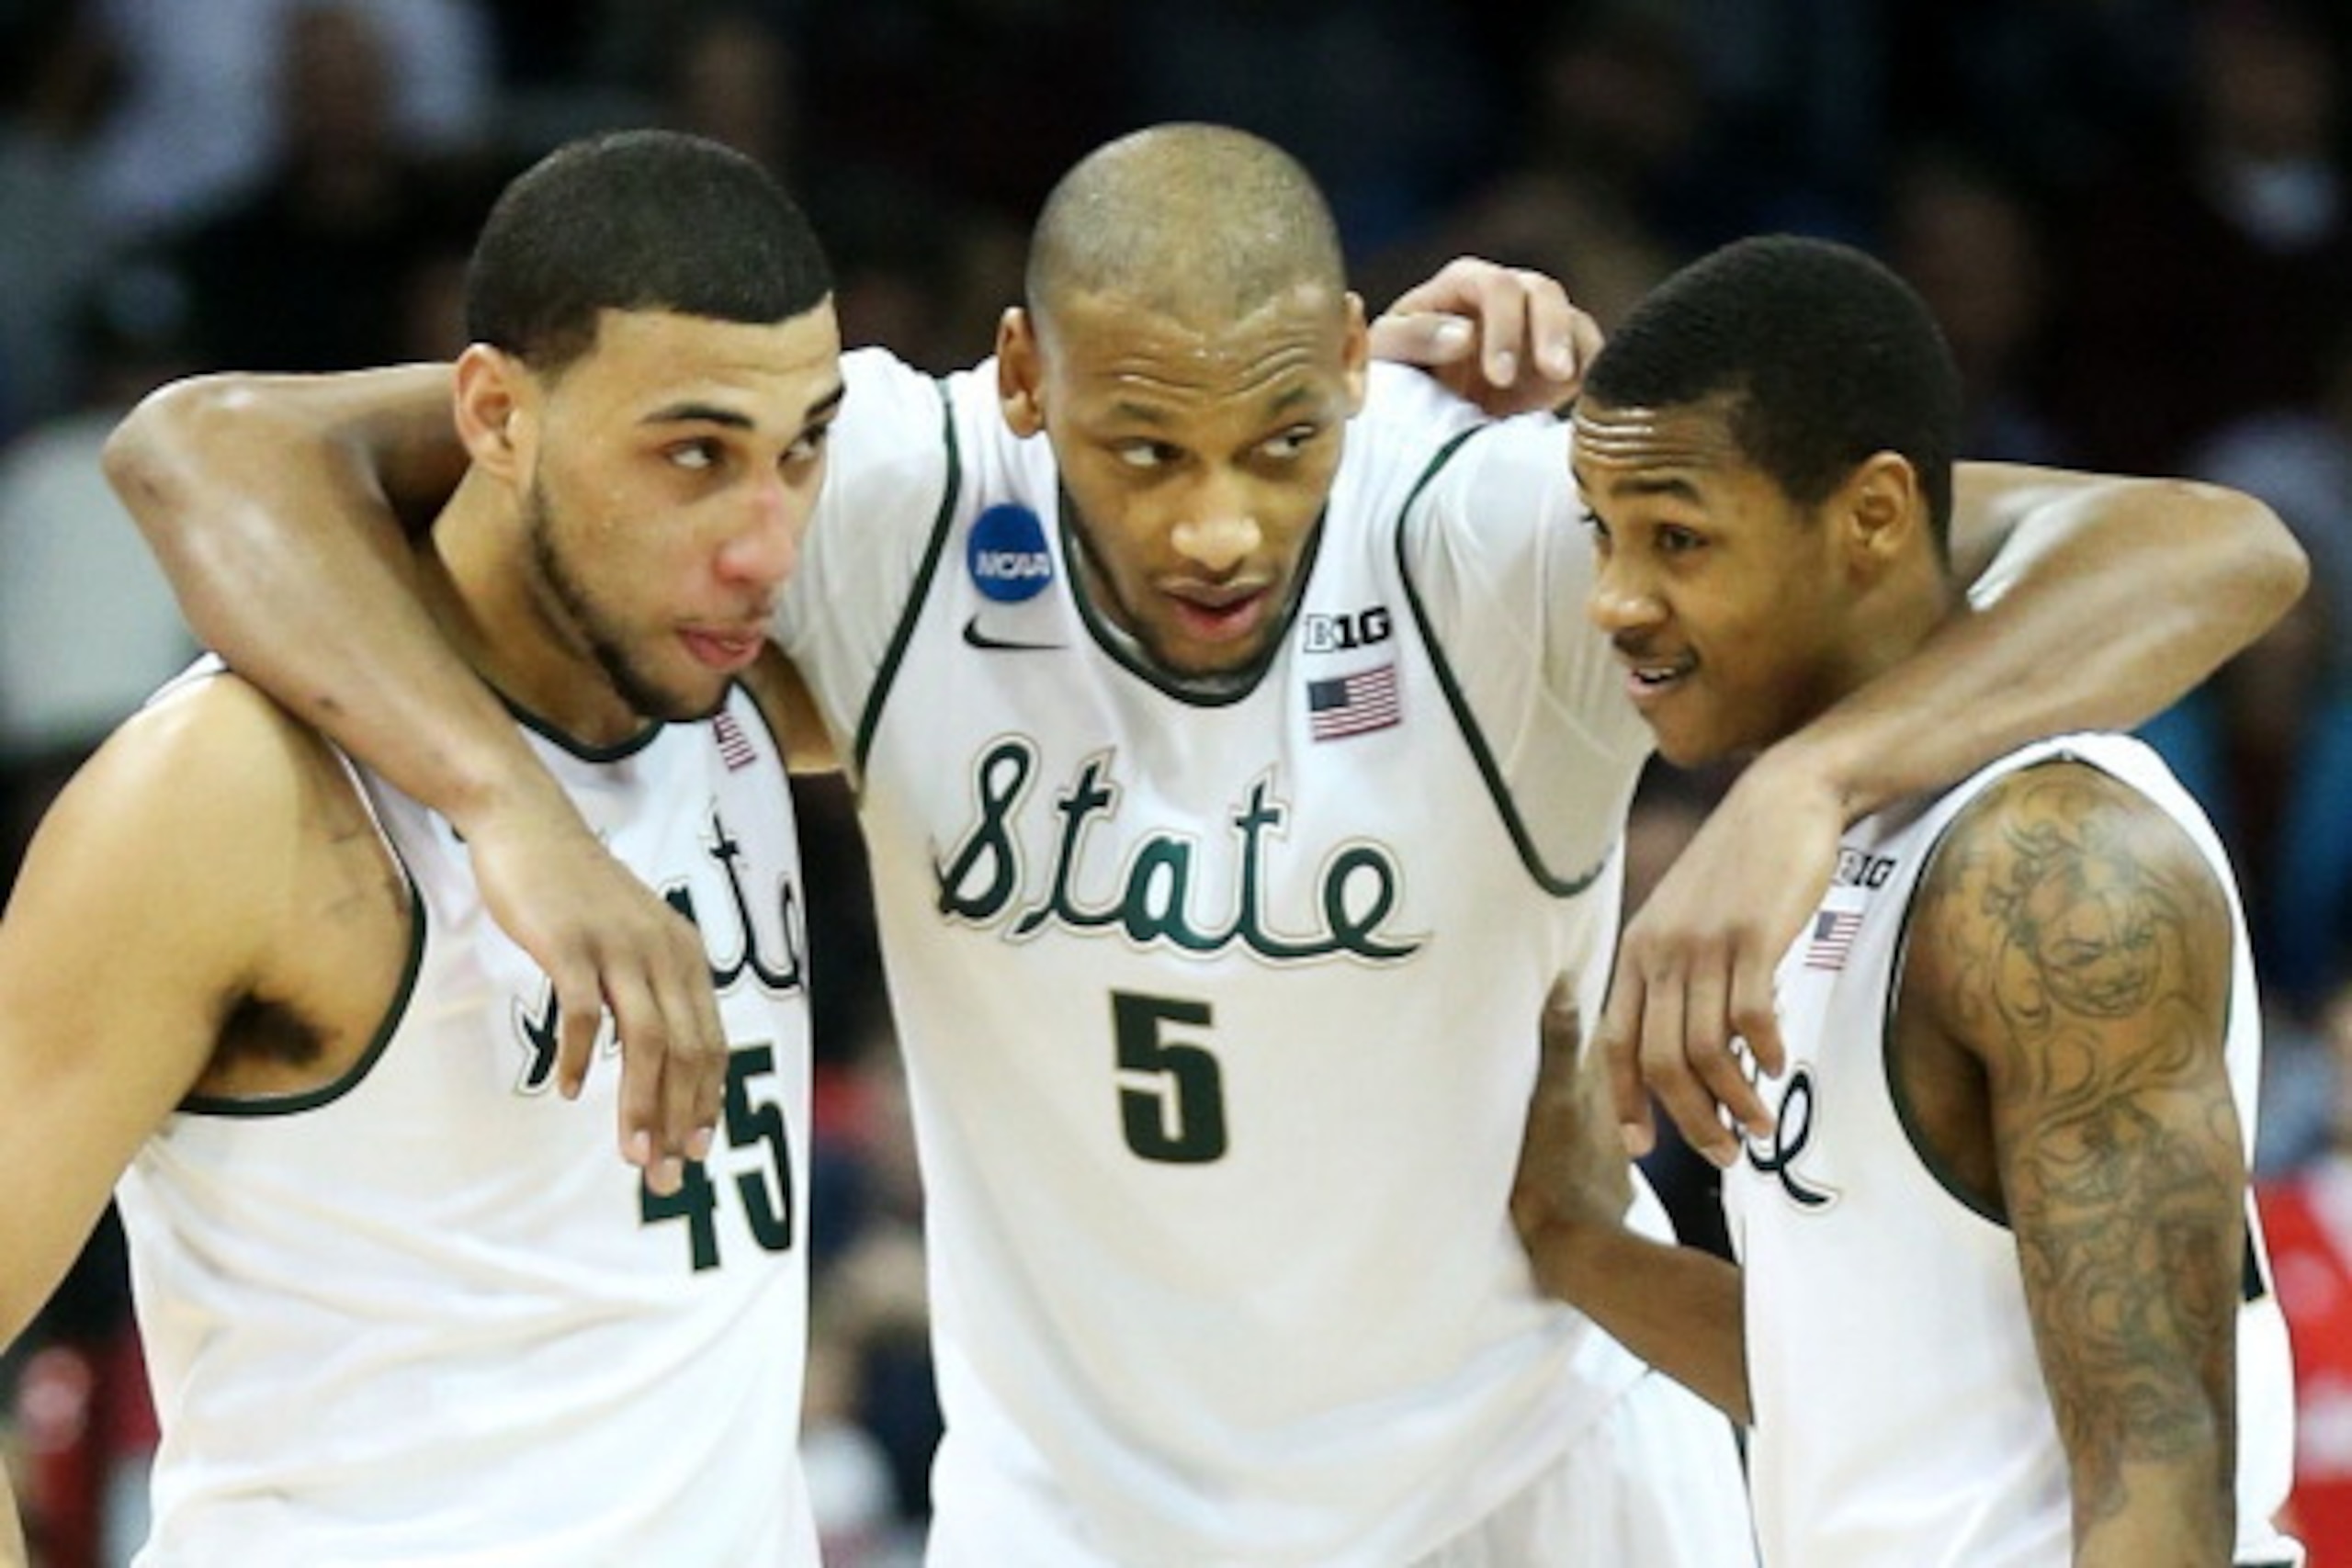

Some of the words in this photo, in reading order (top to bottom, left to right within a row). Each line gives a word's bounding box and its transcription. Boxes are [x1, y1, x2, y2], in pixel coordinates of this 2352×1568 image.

[976, 551, 1050, 581] NCAA
[928, 735, 1431, 966] State
[639, 1042, 794, 1271] 45
[1109, 988, 1228, 1165] 5
